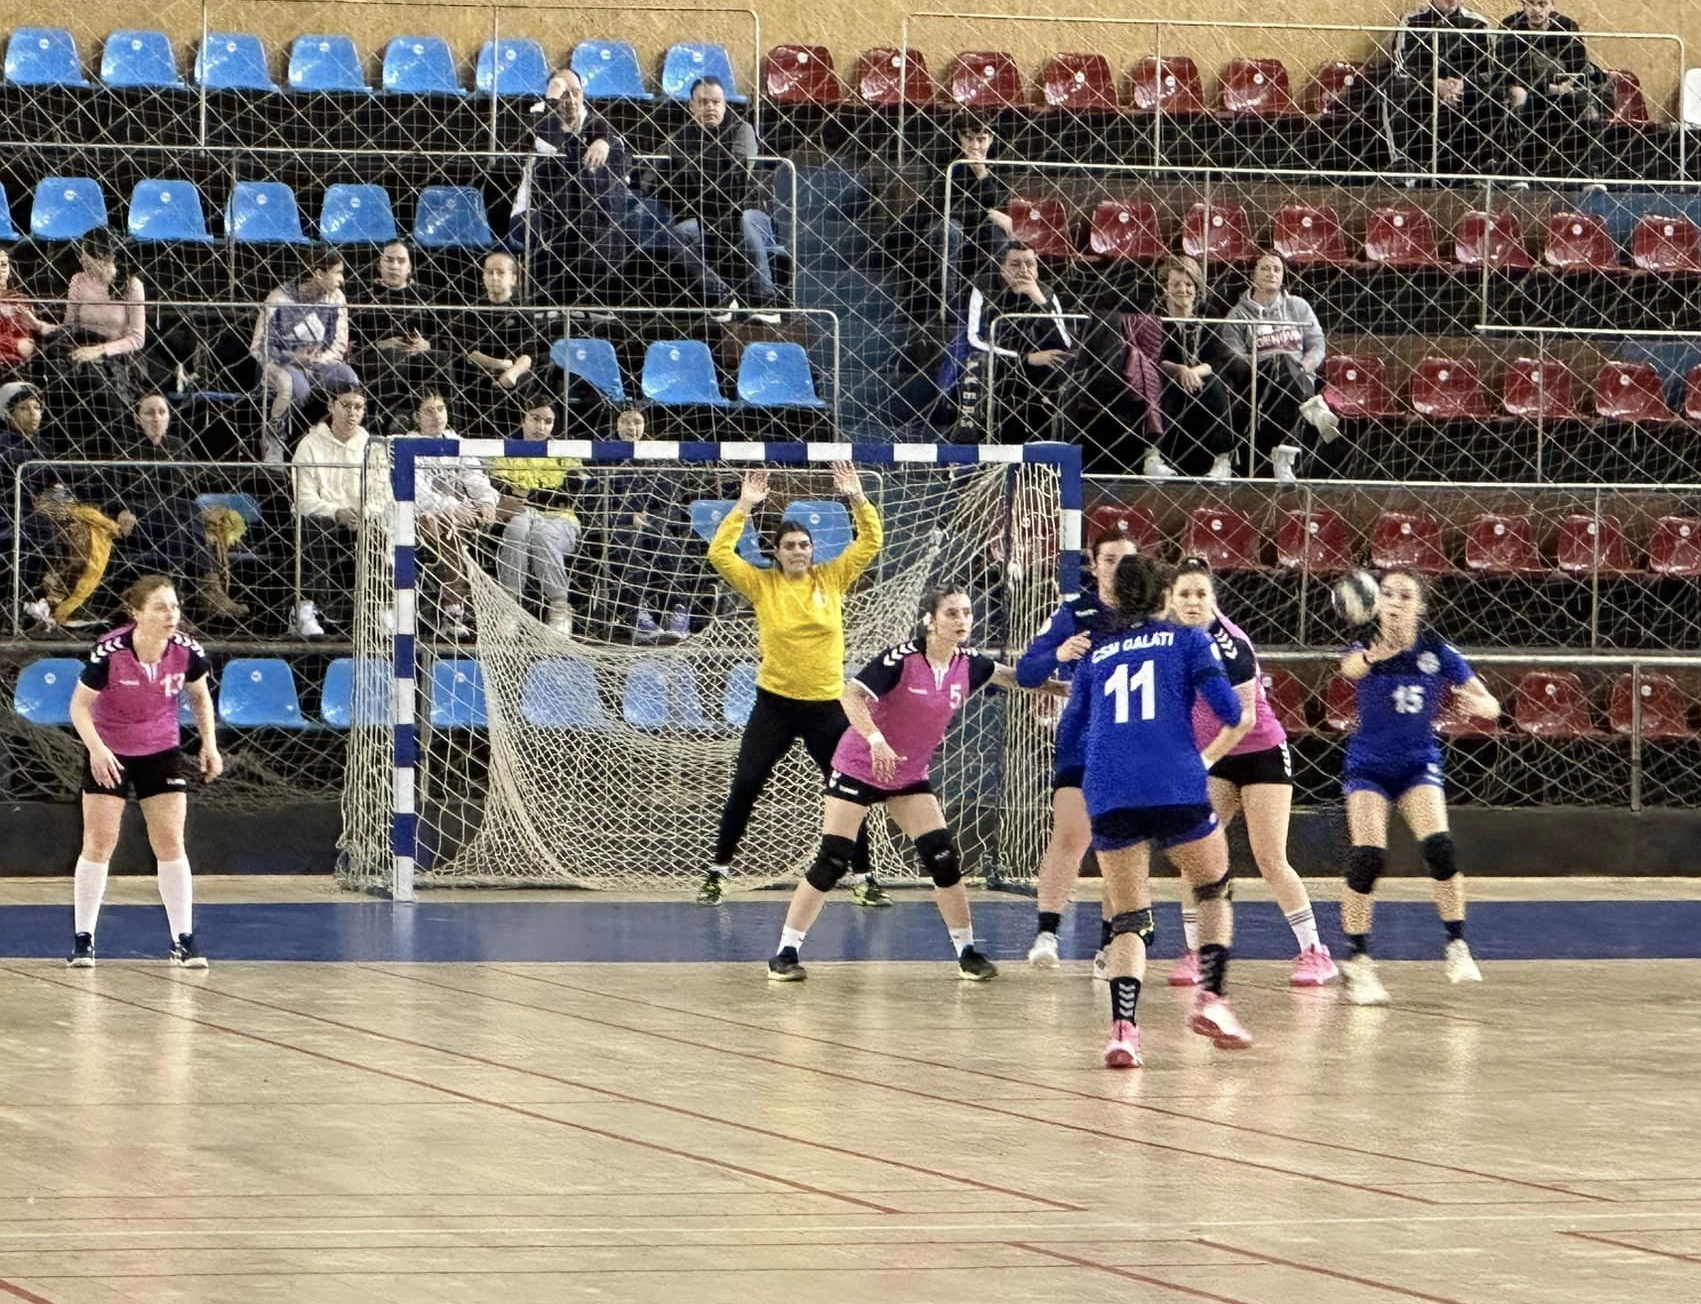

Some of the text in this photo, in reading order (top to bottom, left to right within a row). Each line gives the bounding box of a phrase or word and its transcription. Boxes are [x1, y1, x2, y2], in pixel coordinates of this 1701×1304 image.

[949, 683, 962, 710] 5
[1104, 660, 1156, 724] 11
[1392, 684, 1424, 714] 15
